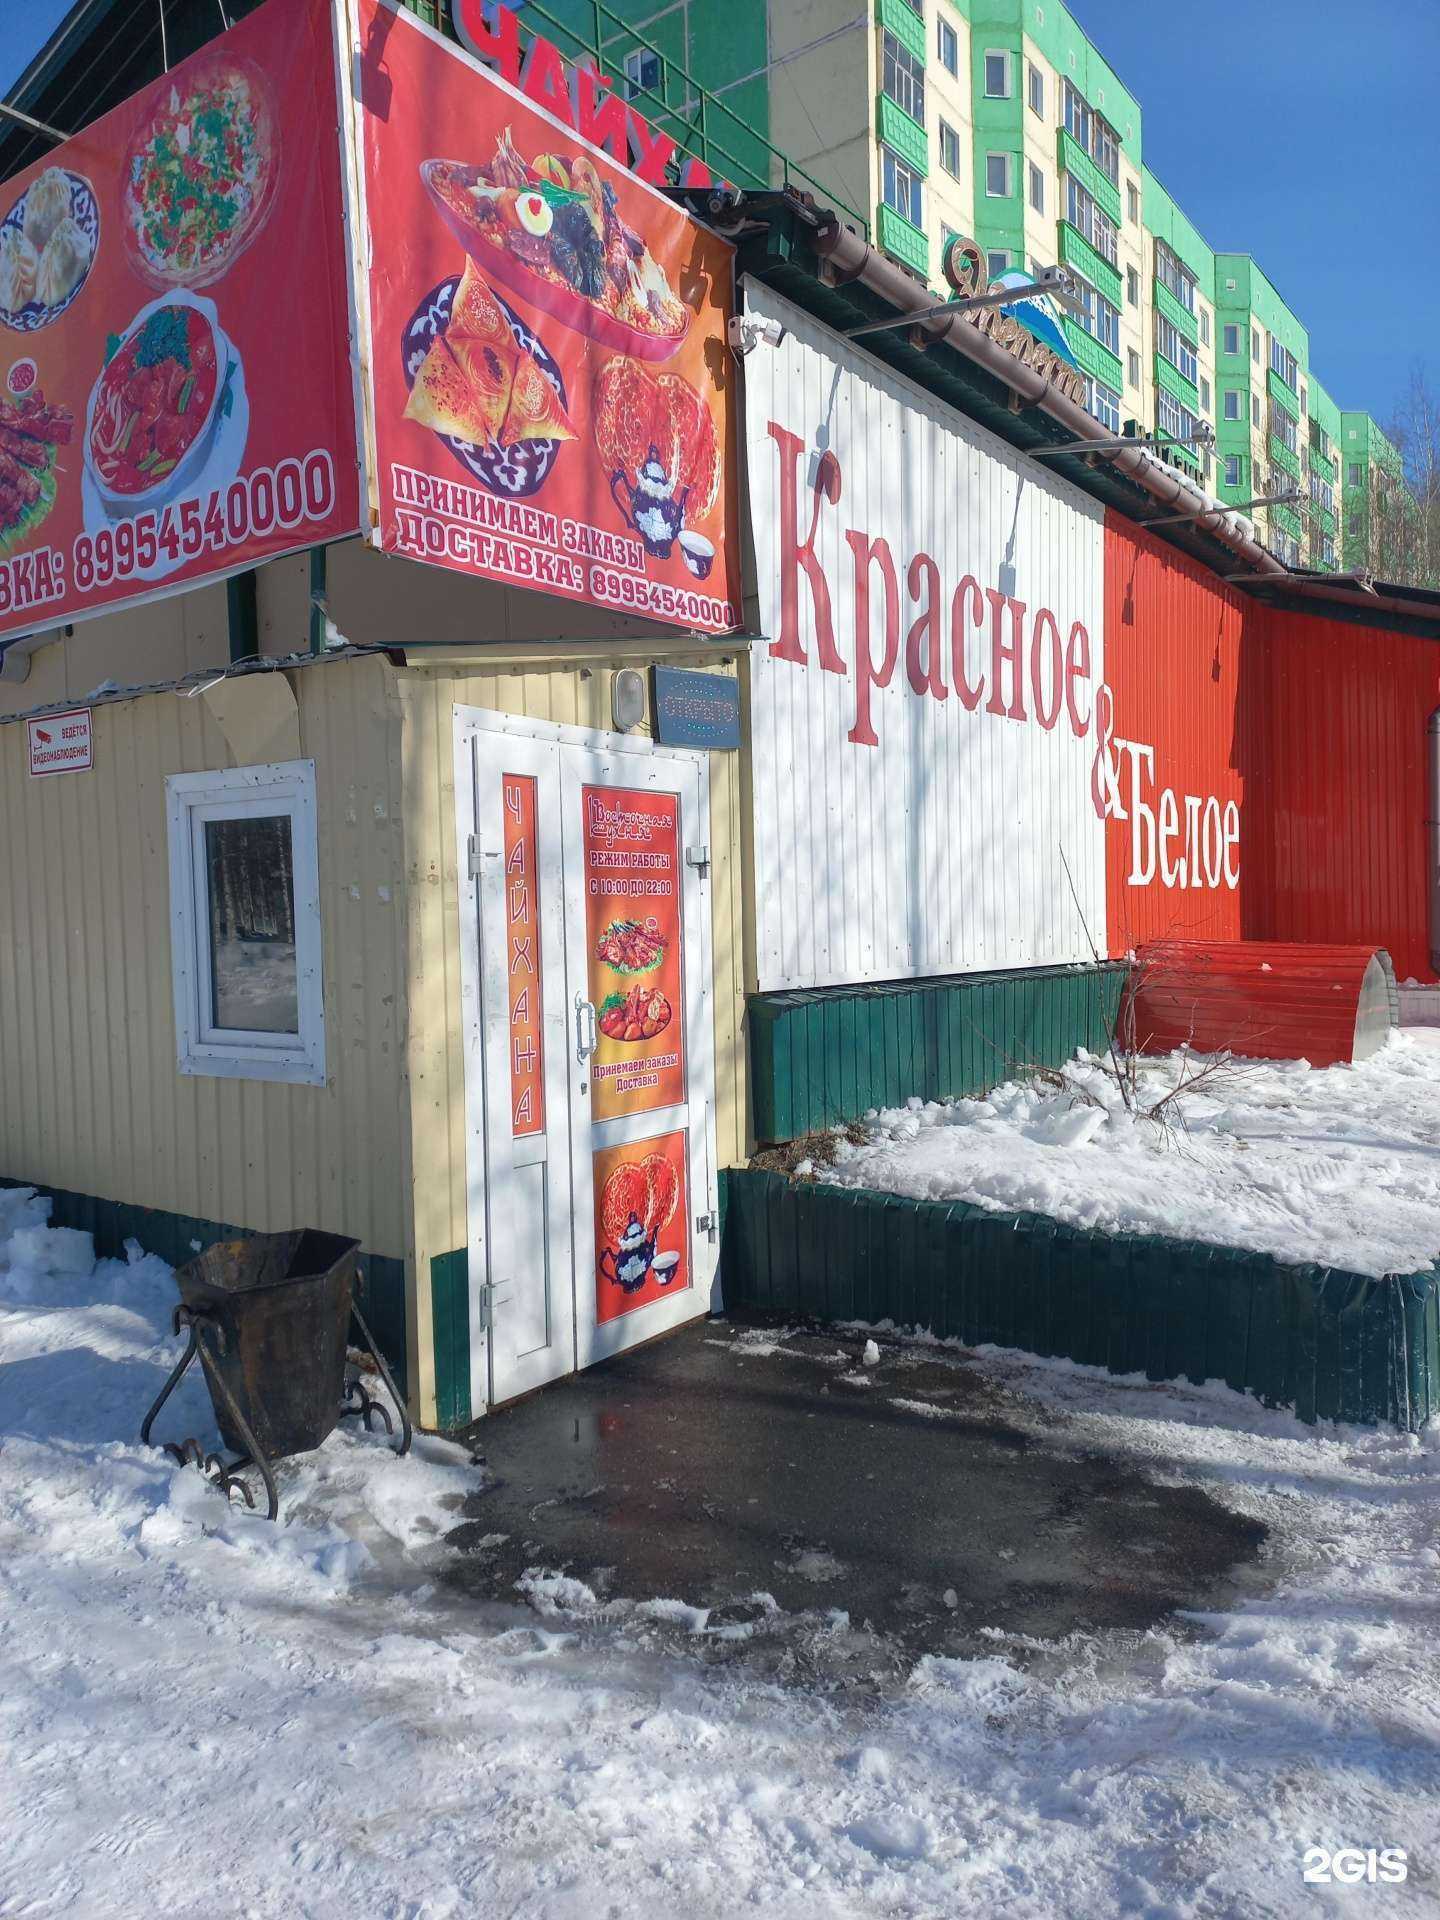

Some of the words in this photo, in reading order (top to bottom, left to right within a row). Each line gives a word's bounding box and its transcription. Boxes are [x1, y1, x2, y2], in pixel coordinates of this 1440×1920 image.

[73, 449, 336, 592] 89954540000
[391, 464, 558, 547] ПРИНИМАЕМ
[561, 518, 645, 573] ЗАКАЗЫ
[395, 508, 585, 593] ДОСТАВКА:
[590, 566, 735, 629] 89954540000
[767, 420, 1091, 746] Красное
[1091, 683, 1128, 821] &
[1113, 737, 1240, 890] Белое
[33, 745, 88, 765] ВИДЕОНАБЛЮДЕНИЕ
[590, 851, 630, 867] РЕЖИМ
[631, 852, 671, 869] РАБОТЫ
[590, 878, 598, 894] С
[600, 878, 628, 895] 10:00
[630, 879, 644, 897] ДО
[646, 879, 672, 896] 22:00
[505, 784, 536, 1126] ЧАЙХАНА
[593, 1058, 645, 1080] Принемаем
[646, 1053, 678, 1071] заказы
[616, 1073, 658, 1095] Доставка
